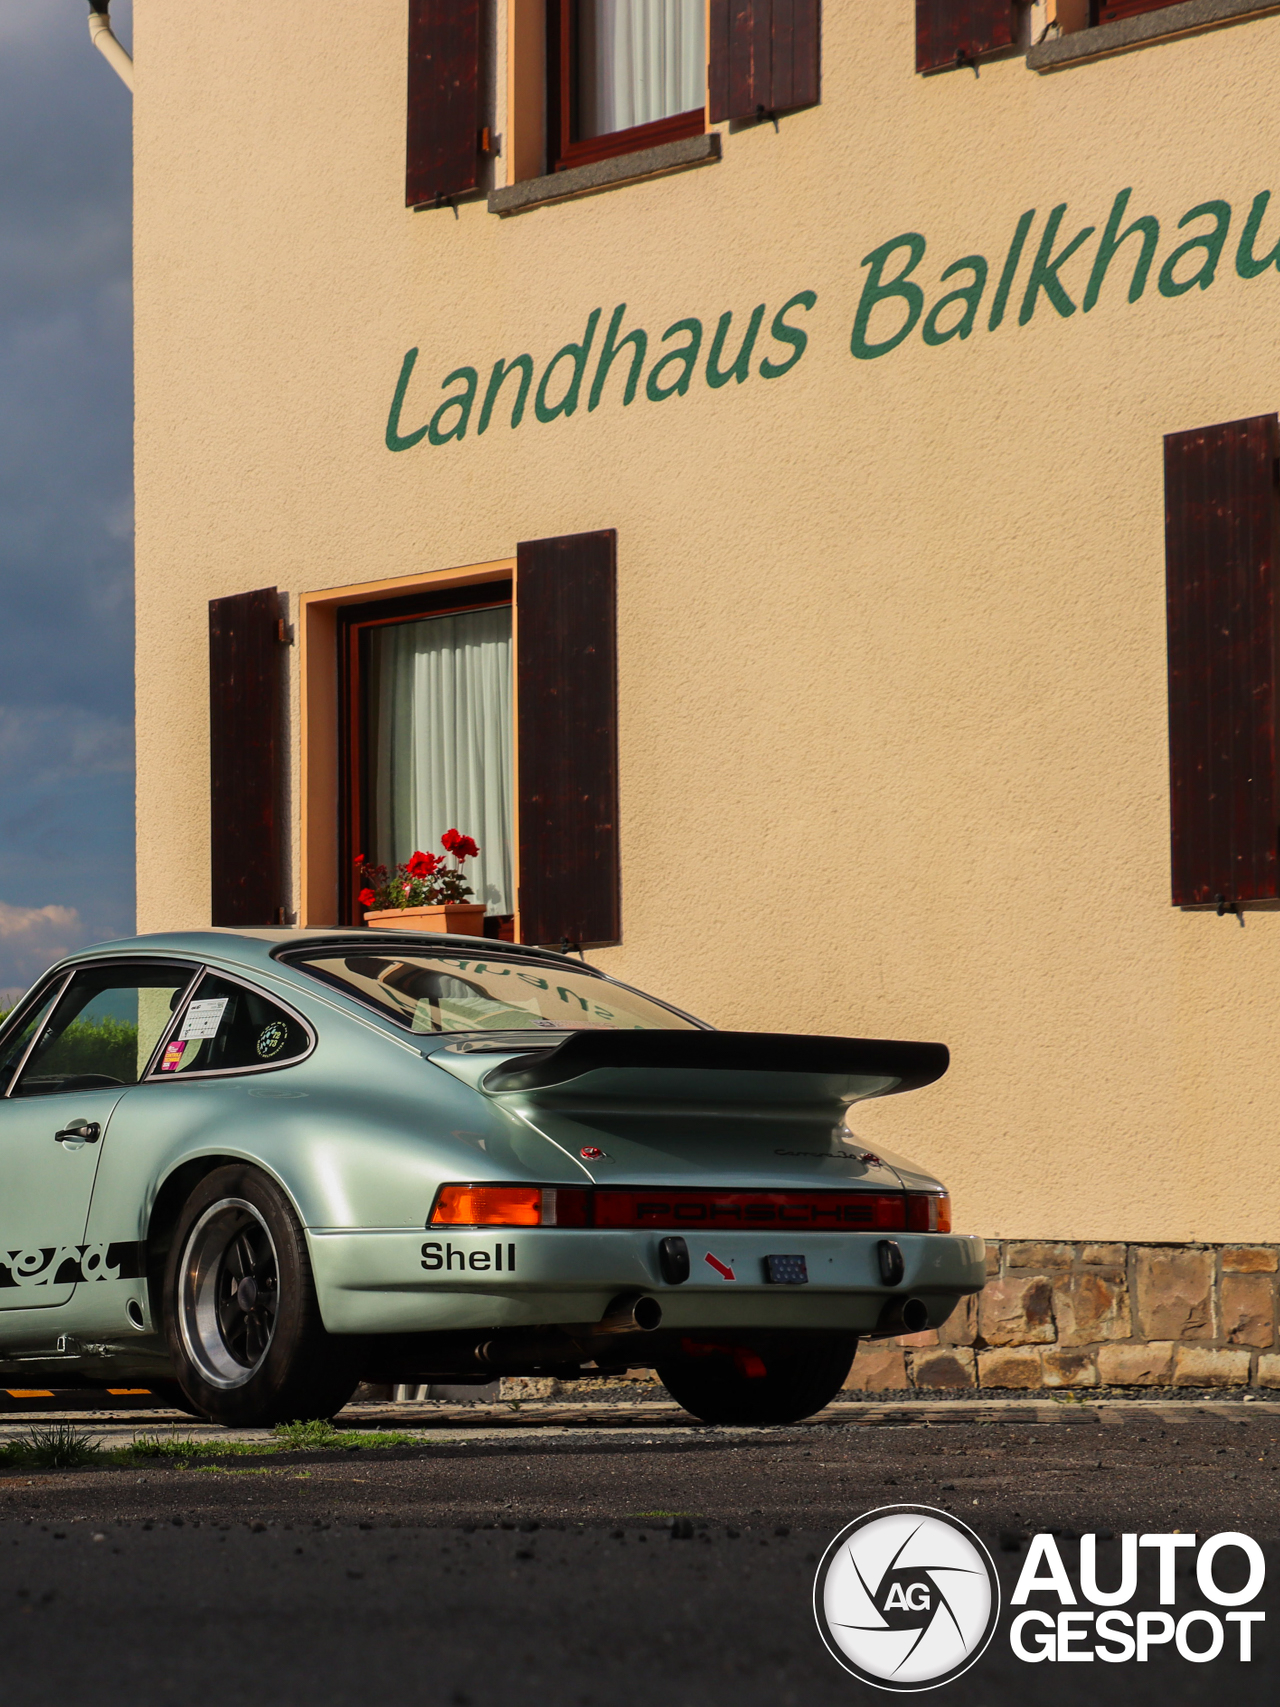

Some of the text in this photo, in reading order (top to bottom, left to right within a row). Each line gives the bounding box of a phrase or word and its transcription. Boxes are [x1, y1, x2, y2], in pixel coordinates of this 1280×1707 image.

[385, 289, 817, 452] Landhaus
[774, 1149, 841, 1158] Carrera
[636, 1202, 874, 1222] PORSCHE
[420, 1242, 516, 1271] Shell
